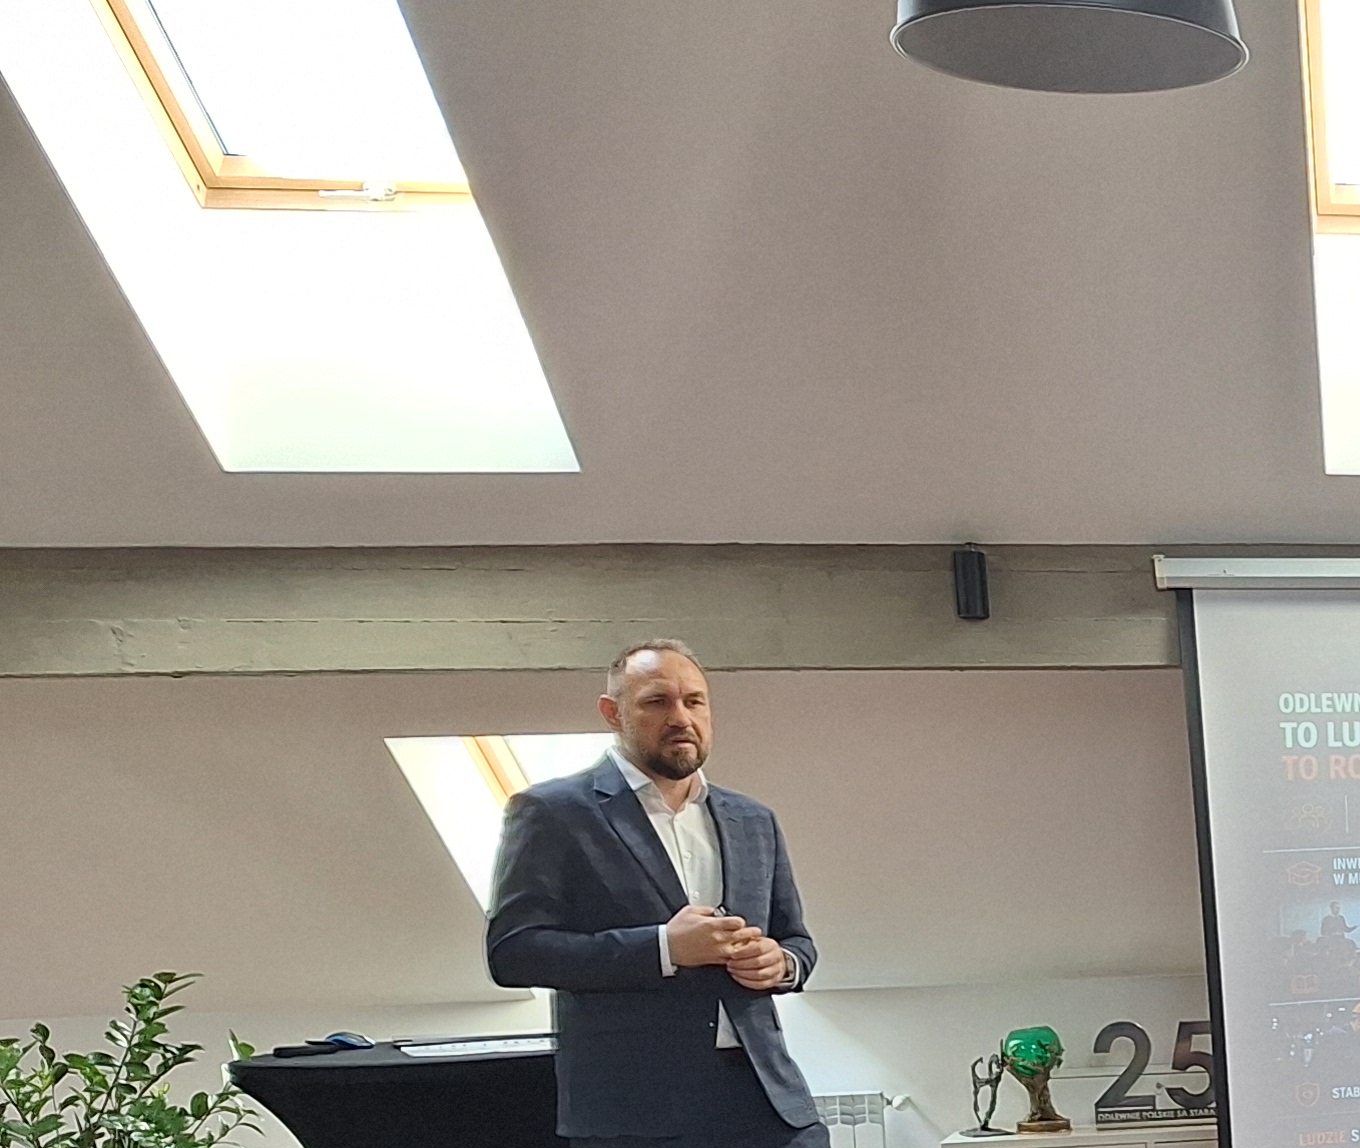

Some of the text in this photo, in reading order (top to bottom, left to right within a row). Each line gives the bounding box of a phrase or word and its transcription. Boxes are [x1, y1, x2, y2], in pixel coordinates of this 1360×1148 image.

[1279, 721, 1318, 748] TO
[1281, 754, 1318, 780] TO
[1333, 872, 1345, 885] W
[1093, 1020, 1214, 1109] 25
[1299, 1130, 1346, 1147] LUDZIE
